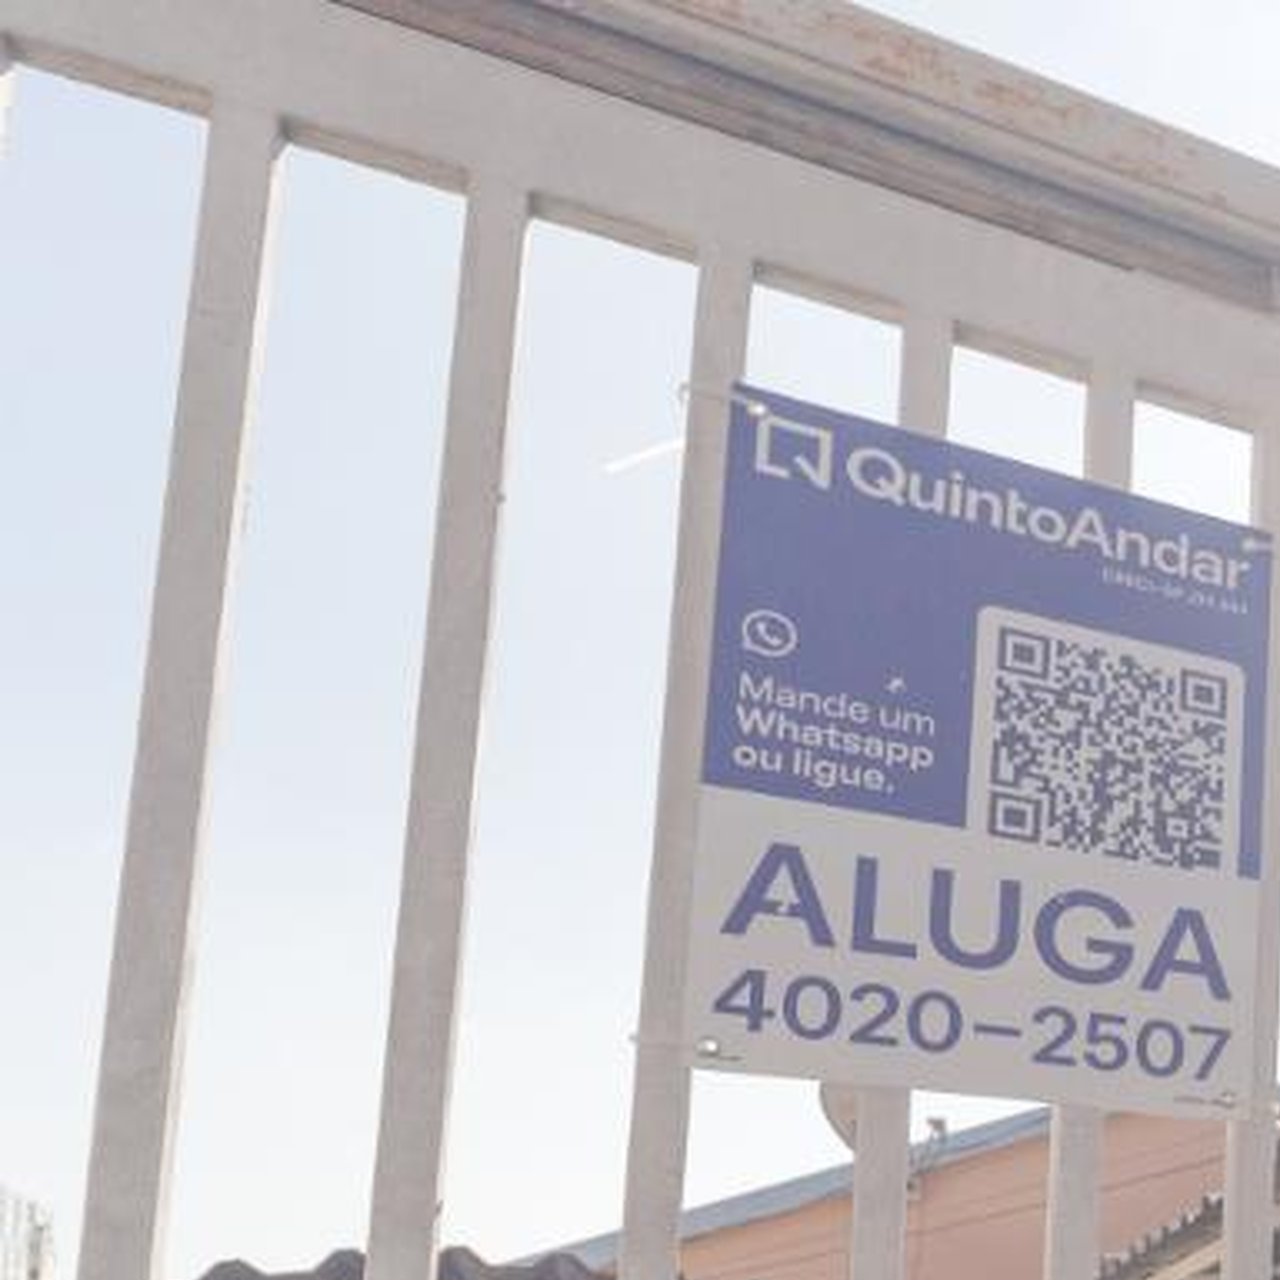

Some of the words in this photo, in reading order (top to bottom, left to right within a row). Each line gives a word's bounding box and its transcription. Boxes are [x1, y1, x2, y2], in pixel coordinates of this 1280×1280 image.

[848, 447, 1250, 590] QuintoAndar
[735, 703, 934, 772] Whatsapp
[739, 670, 870, 723] Mande
[878, 705, 935, 737] um
[734, 745, 782, 773] ou
[793, 748, 896, 794] ligue.
[720, 842, 1231, 1000] ALUGA
[713, 969, 1231, 1081] 4020-2507
